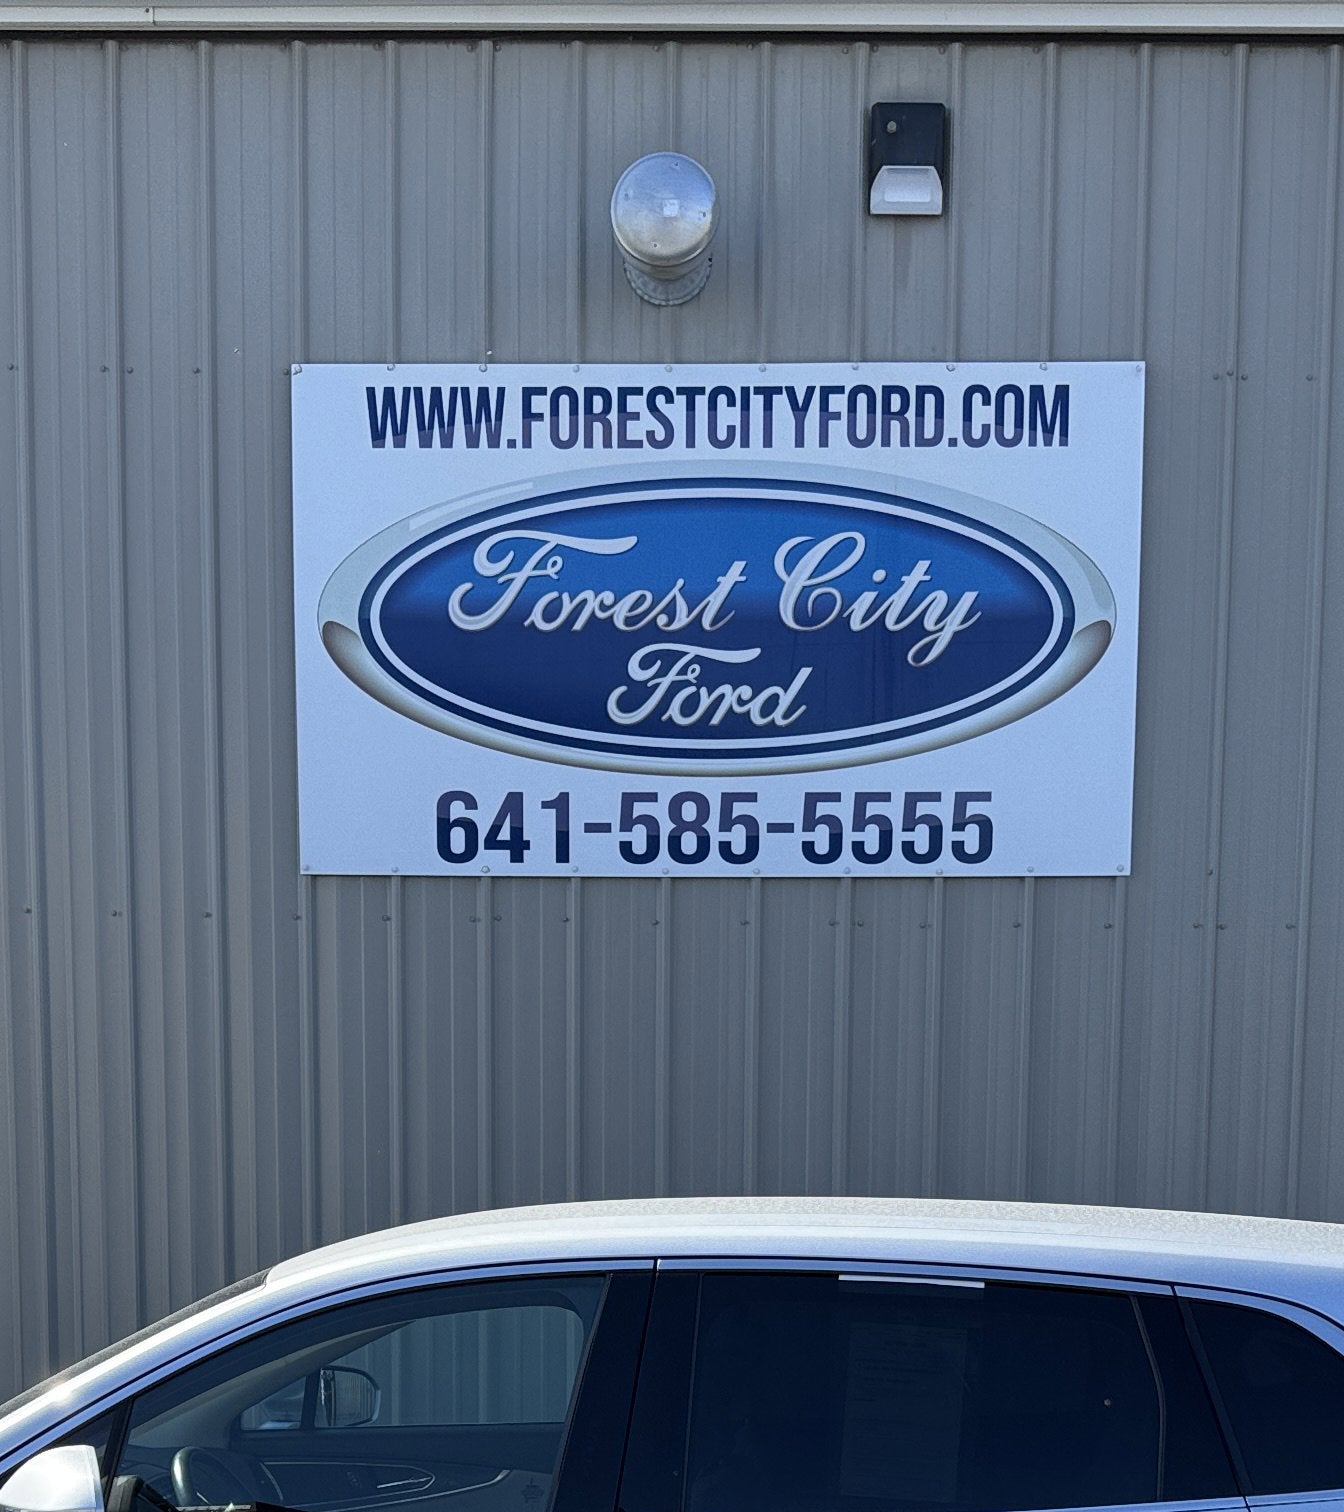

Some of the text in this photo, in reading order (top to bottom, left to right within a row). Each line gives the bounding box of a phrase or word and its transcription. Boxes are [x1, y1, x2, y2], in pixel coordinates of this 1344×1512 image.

[365, 384, 1070, 449] WWW.FORESTCITYFORD.COM
[446, 529, 982, 667] Forest City
[606, 642, 812, 728] Ford
[436, 790, 994, 865] 641-585-5555
